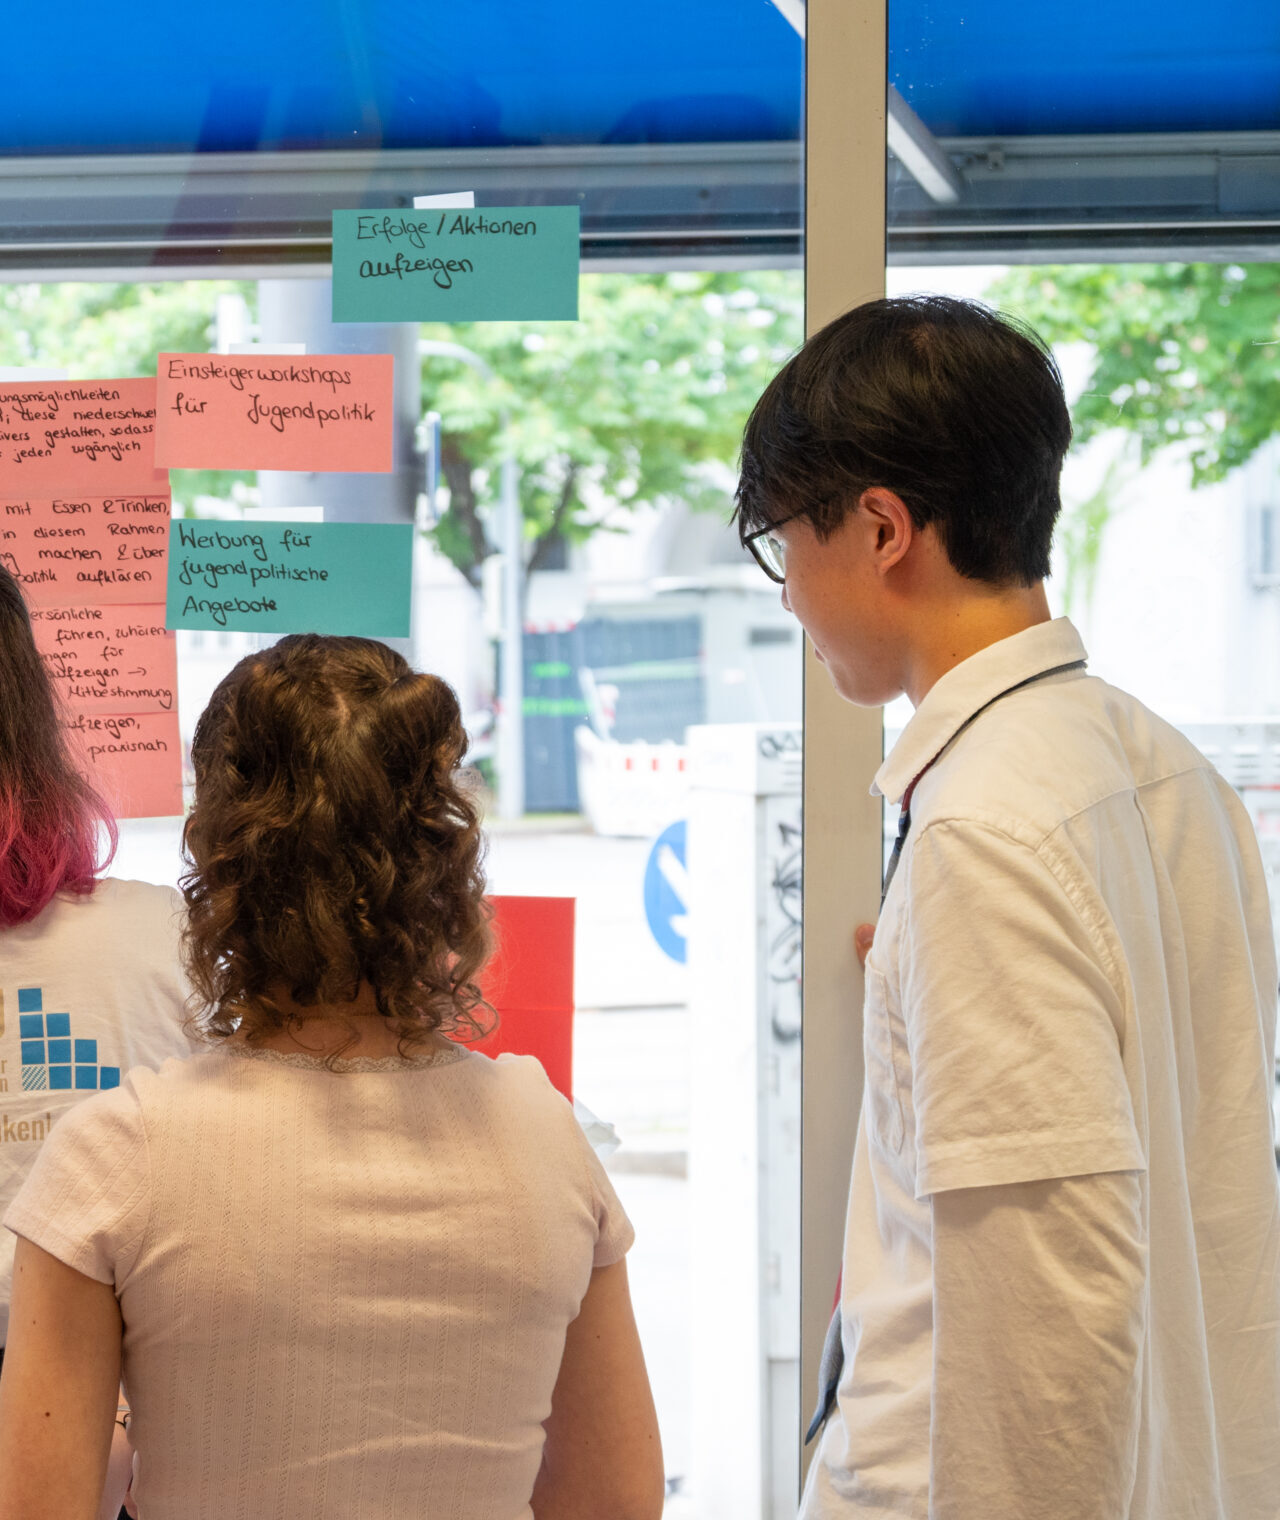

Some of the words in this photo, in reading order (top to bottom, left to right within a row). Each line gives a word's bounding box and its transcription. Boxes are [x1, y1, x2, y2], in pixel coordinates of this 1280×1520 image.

[359, 252, 473, 290] aufzeigen
[21, 408, 57, 422] diese
[73, 407, 157, 421] niederschwel
[171, 392, 208, 416] für
[246, 393, 376, 433] Jugendpolitik
[109, 423, 154, 437] sodass
[12, 447, 53, 464] jeden
[5, 501, 32, 516] mit
[52, 499, 92, 515] Essen
[3, 528, 17, 540] in
[33, 526, 86, 539] diesem
[106, 522, 166, 536] Rahmen
[179, 523, 269, 562] Werbung
[280, 529, 313, 552] für
[38, 546, 103, 562] machen
[132, 546, 166, 561] über
[76, 568, 153, 587] aufklären
[179, 556, 330, 588] jugendpolitische
[29, 607, 103, 621] ersönliche
[182, 595, 278, 626] Angebote
[100, 646, 124, 662] für
[67, 684, 173, 710] Mitbestimmung
[87, 739, 168, 764] praxisnah
